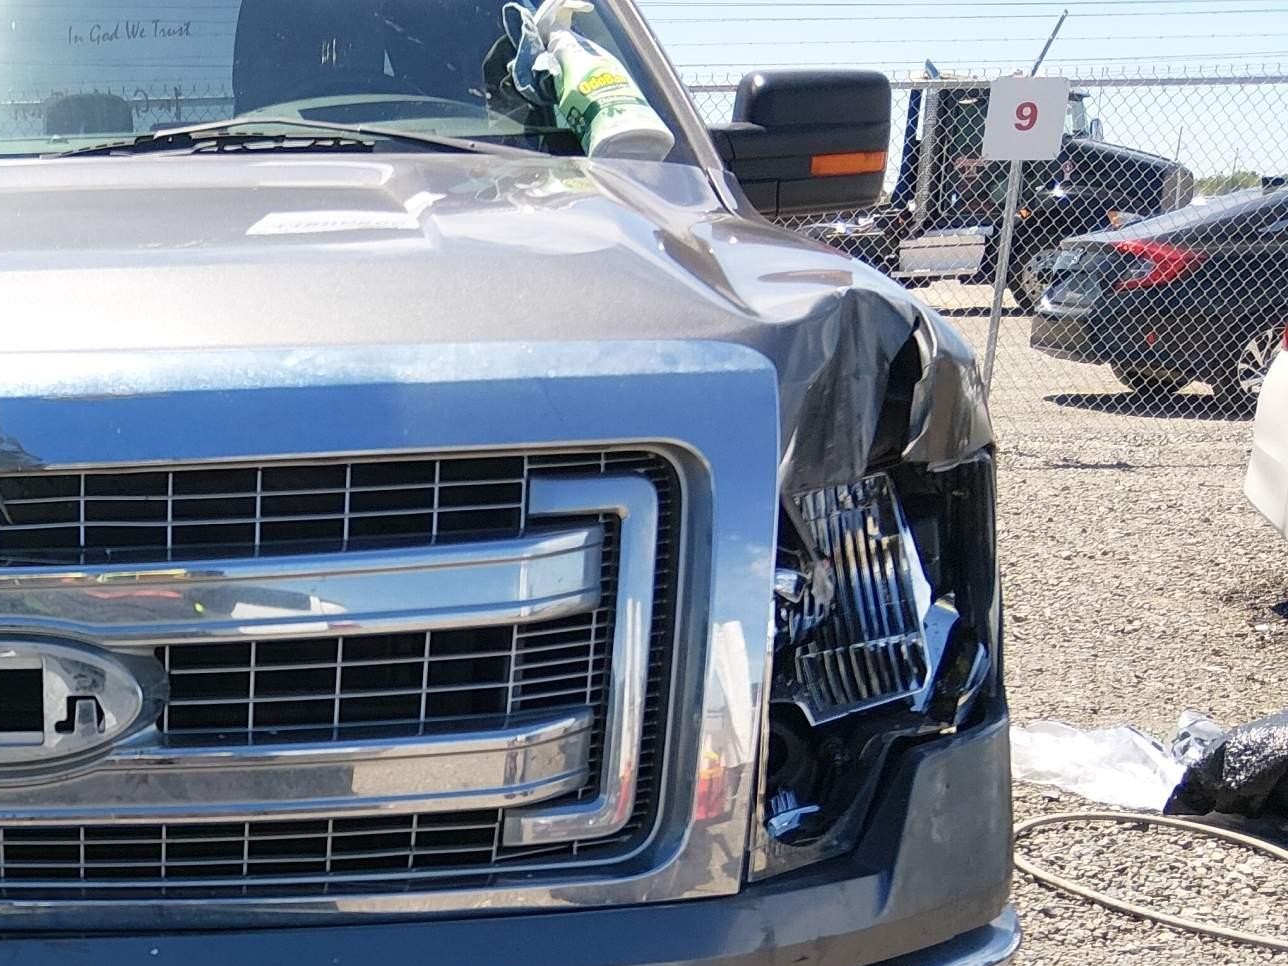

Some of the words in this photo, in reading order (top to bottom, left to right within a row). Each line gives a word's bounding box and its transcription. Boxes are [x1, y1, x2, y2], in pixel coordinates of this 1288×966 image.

[68, 25, 84, 45] In
[89, 23, 120, 46] God
[125, 20, 146, 39] We
[151, 18, 192, 39] Trust
[1014, 102, 1038, 131] 9
